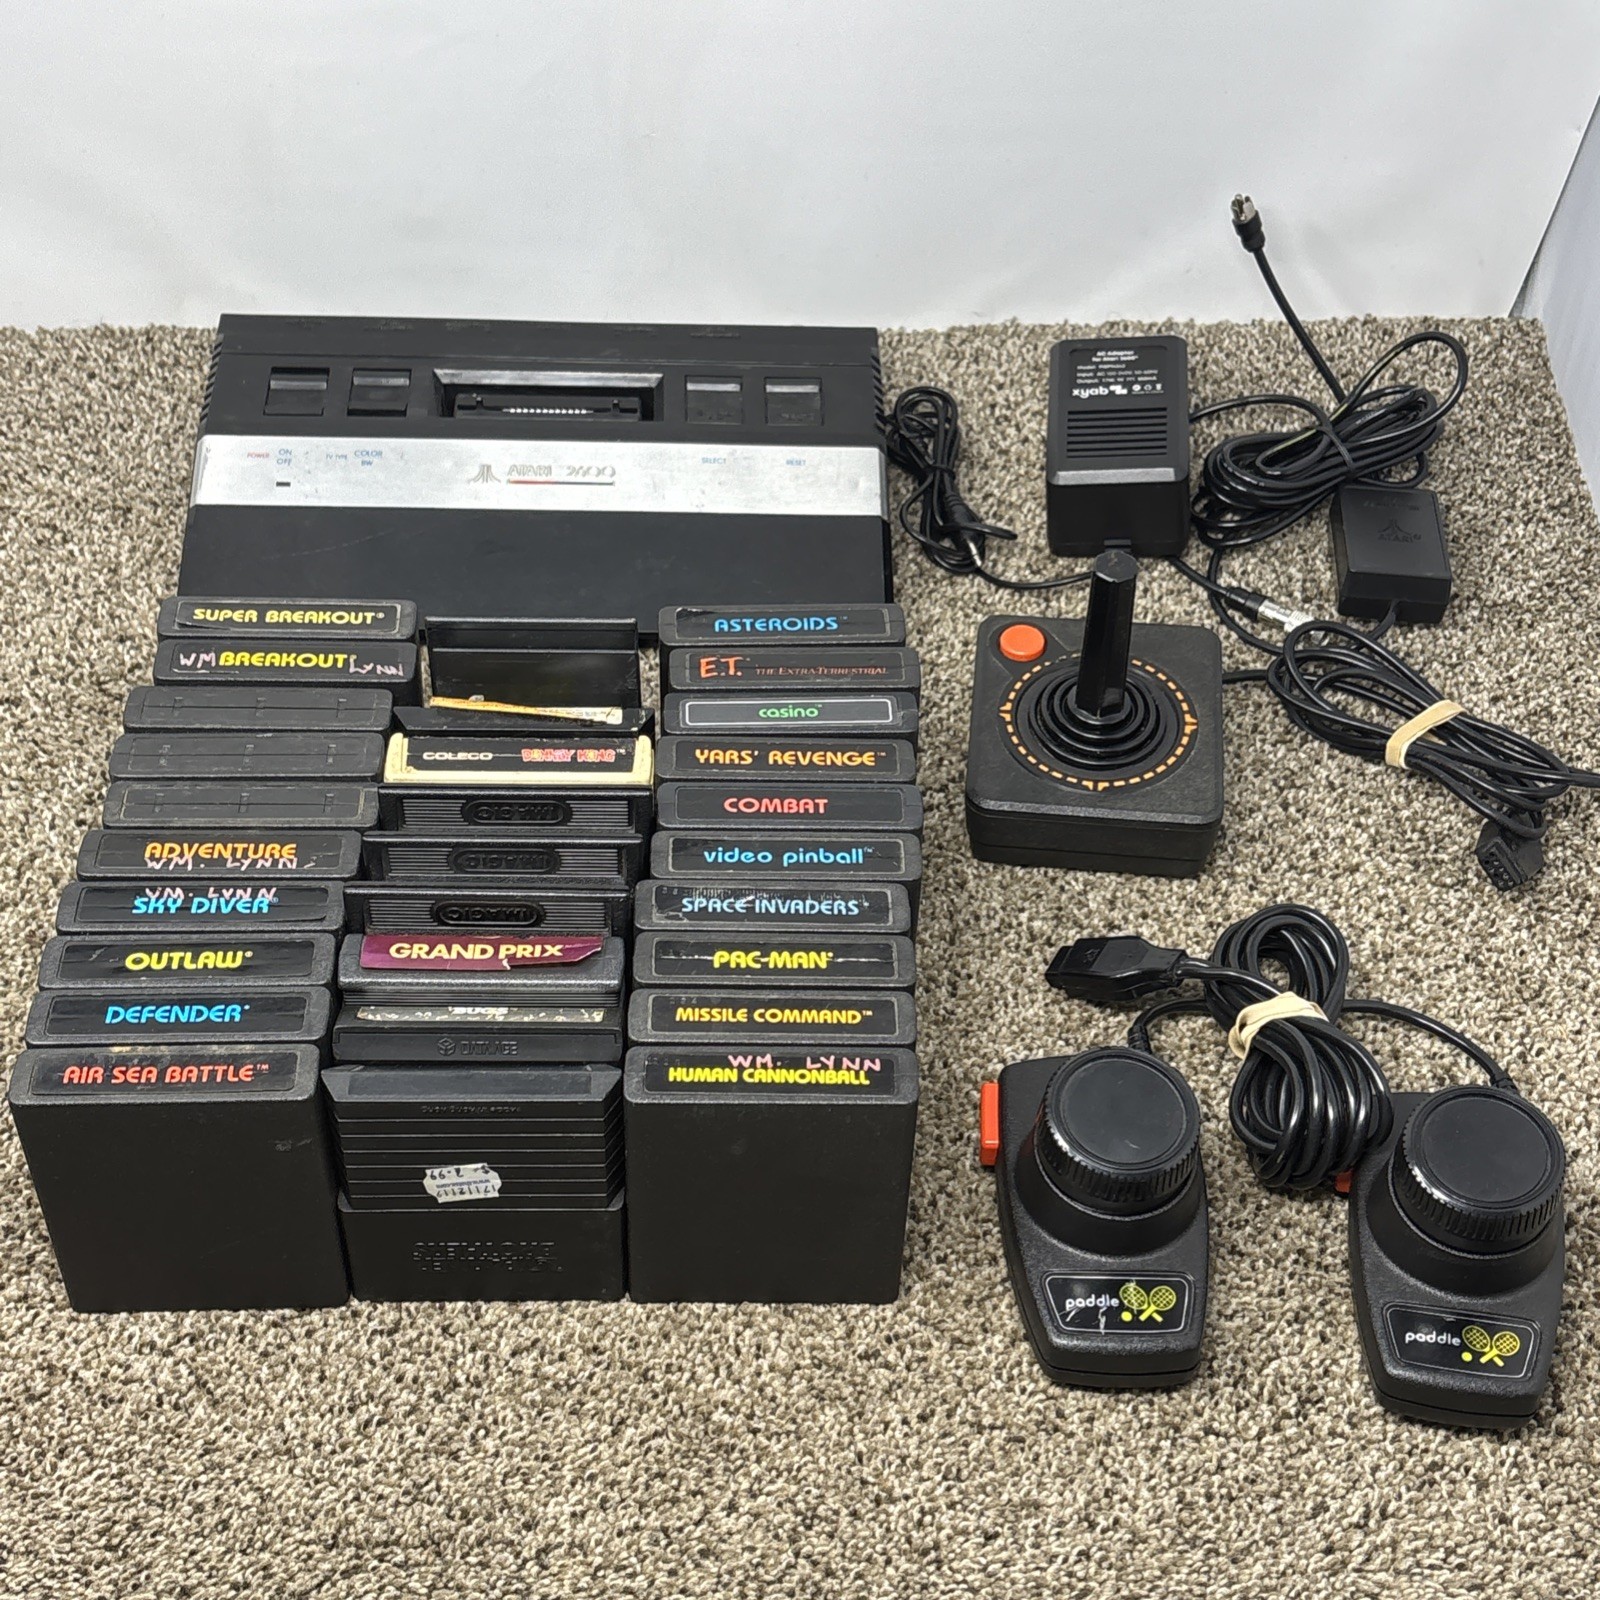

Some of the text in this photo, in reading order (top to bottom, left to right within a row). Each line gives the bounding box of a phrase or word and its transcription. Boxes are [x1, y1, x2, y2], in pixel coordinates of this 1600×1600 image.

[1072, 386, 1109, 399] xyab
[246, 451, 270, 459] POWER
[278, 448, 292, 456] ON
[354, 449, 383, 459] COLOR
[276, 458, 292, 466] OFF
[701, 457, 727, 465] SELECT
[507, 463, 553, 477] ATARI
[193, 608, 258, 623] SUPER
[700, 656, 744, 679] E.T.
[756, 666, 774, 676] THE
[422, 752, 494, 761] COLECO
[521, 748, 576, 762] DONKEY
[694, 748, 759, 765] YARS'
[723, 797, 829, 814] COMBAT
[144, 842, 297, 860] ADVENTURE
[703, 846, 773, 864] video
[132, 896, 183, 914] SKY
[681, 897, 748, 914] SPACE
[388, 942, 564, 960] GRAND PRIX
[675, 1007, 749, 1023] MISSILE
[806, 1054, 882, 1072] LYNN
[62, 1065, 104, 1085] AIR
[110, 1065, 158, 1085] SEA
[668, 1067, 871, 1086] HUMAN CANNONBALL
[1065, 1293, 1120, 1311] paddle
[1404, 1330, 1462, 1347] paddle
